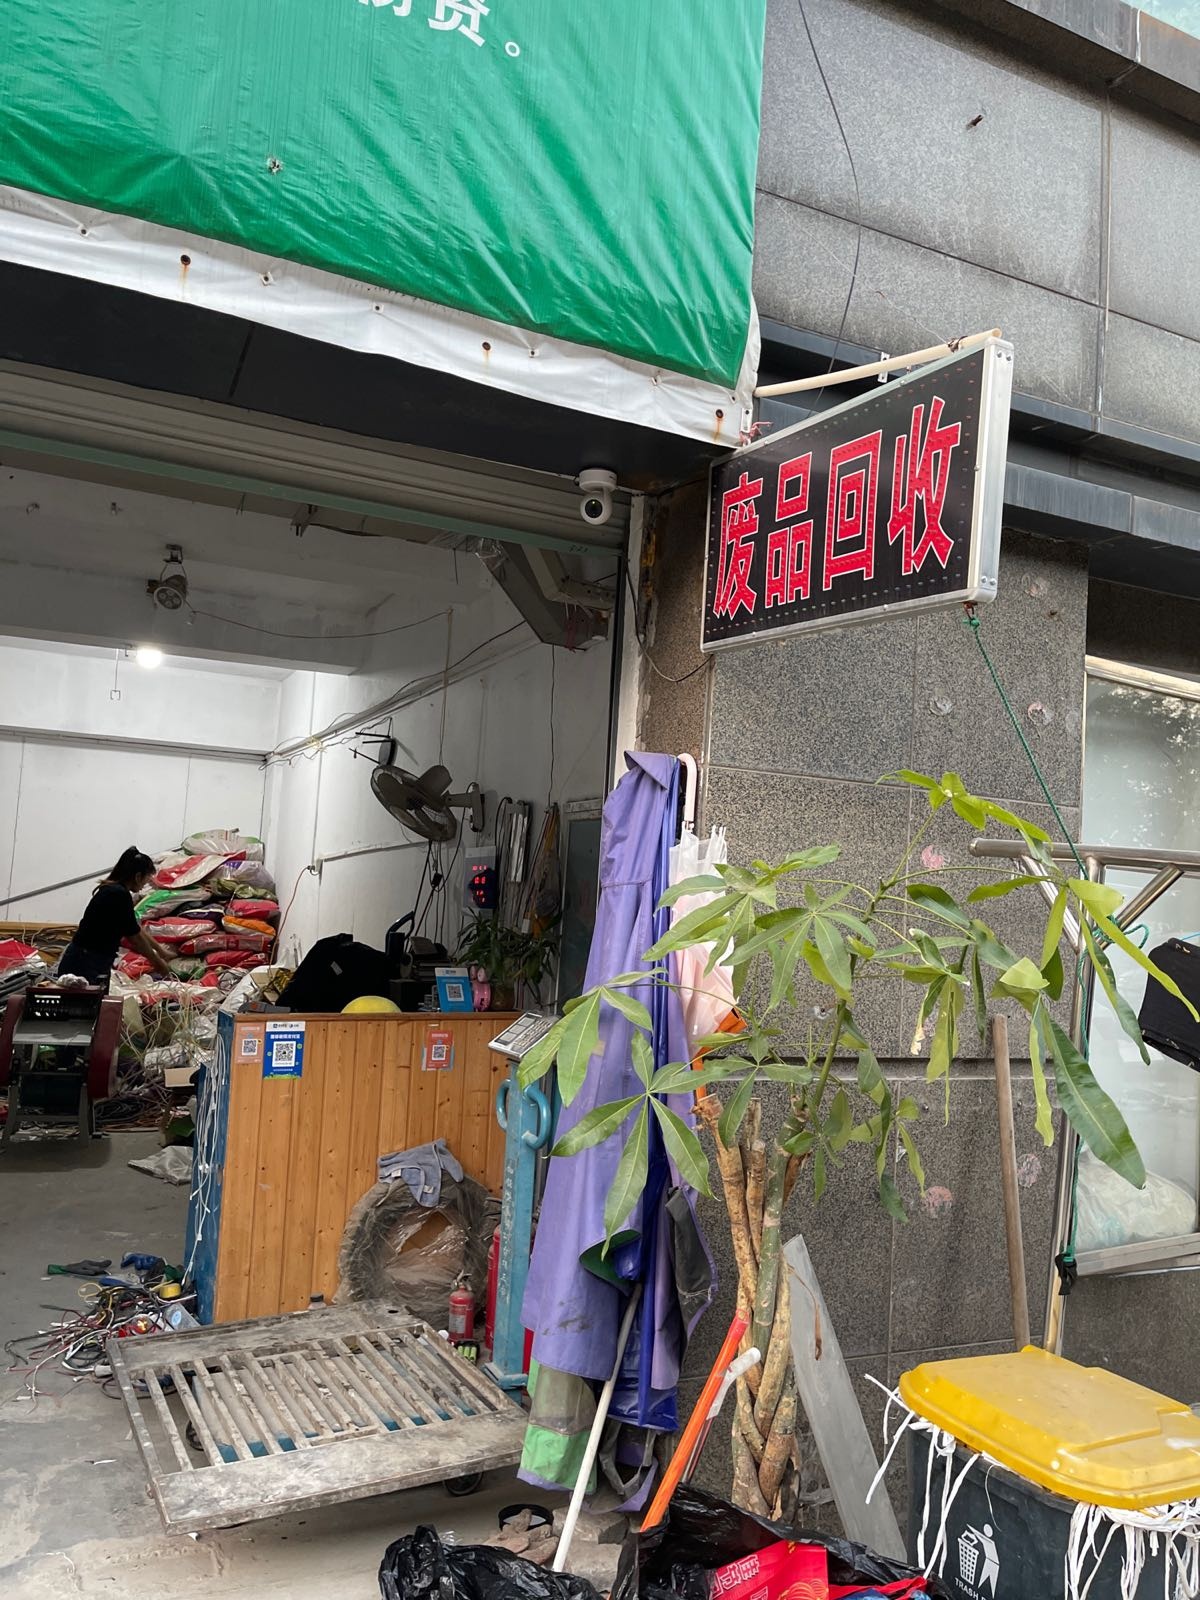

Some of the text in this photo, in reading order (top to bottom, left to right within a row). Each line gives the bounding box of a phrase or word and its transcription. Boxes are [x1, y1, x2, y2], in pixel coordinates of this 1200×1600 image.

[713, 395, 962, 620] 废品回收
[954, 1577, 979, 1600] TRASH
